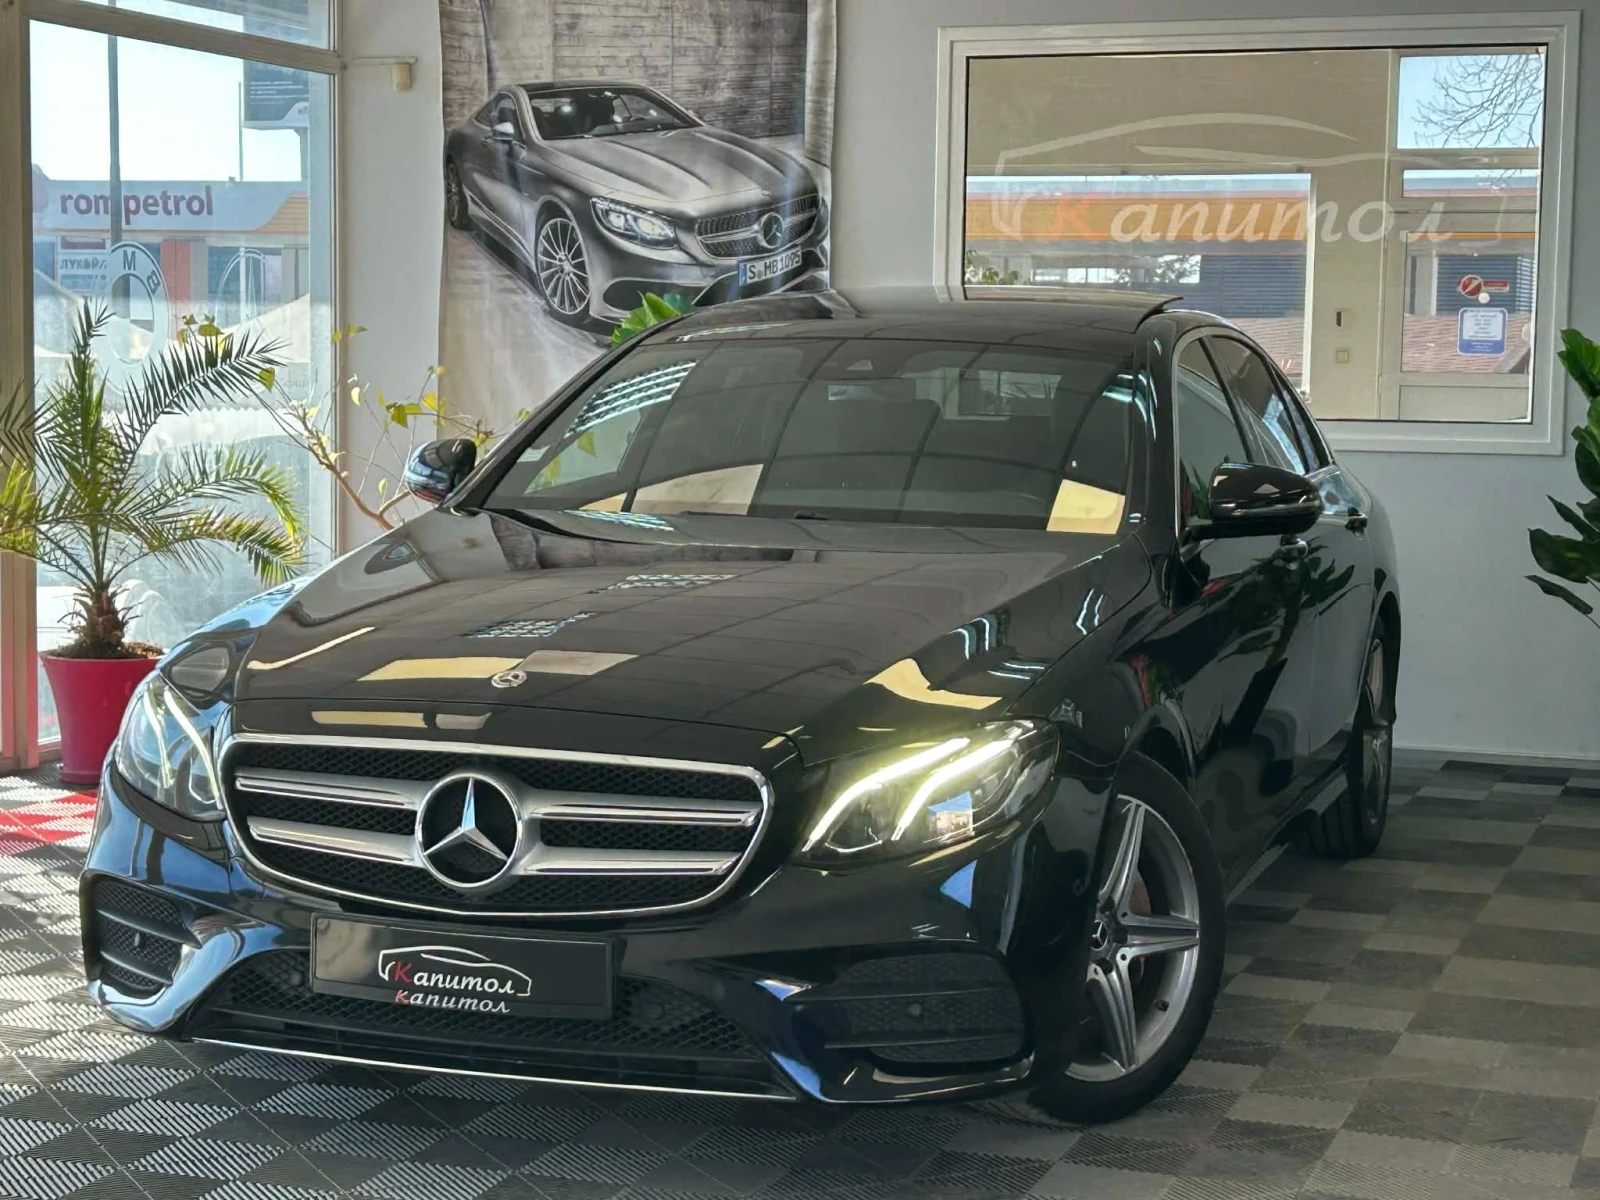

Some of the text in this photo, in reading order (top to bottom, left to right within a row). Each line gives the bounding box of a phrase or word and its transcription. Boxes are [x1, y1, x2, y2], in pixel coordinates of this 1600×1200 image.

[60, 184, 214, 225] rompetrol
[748, 264, 757, 280] S
[394, 960, 515, 994] Капитол
